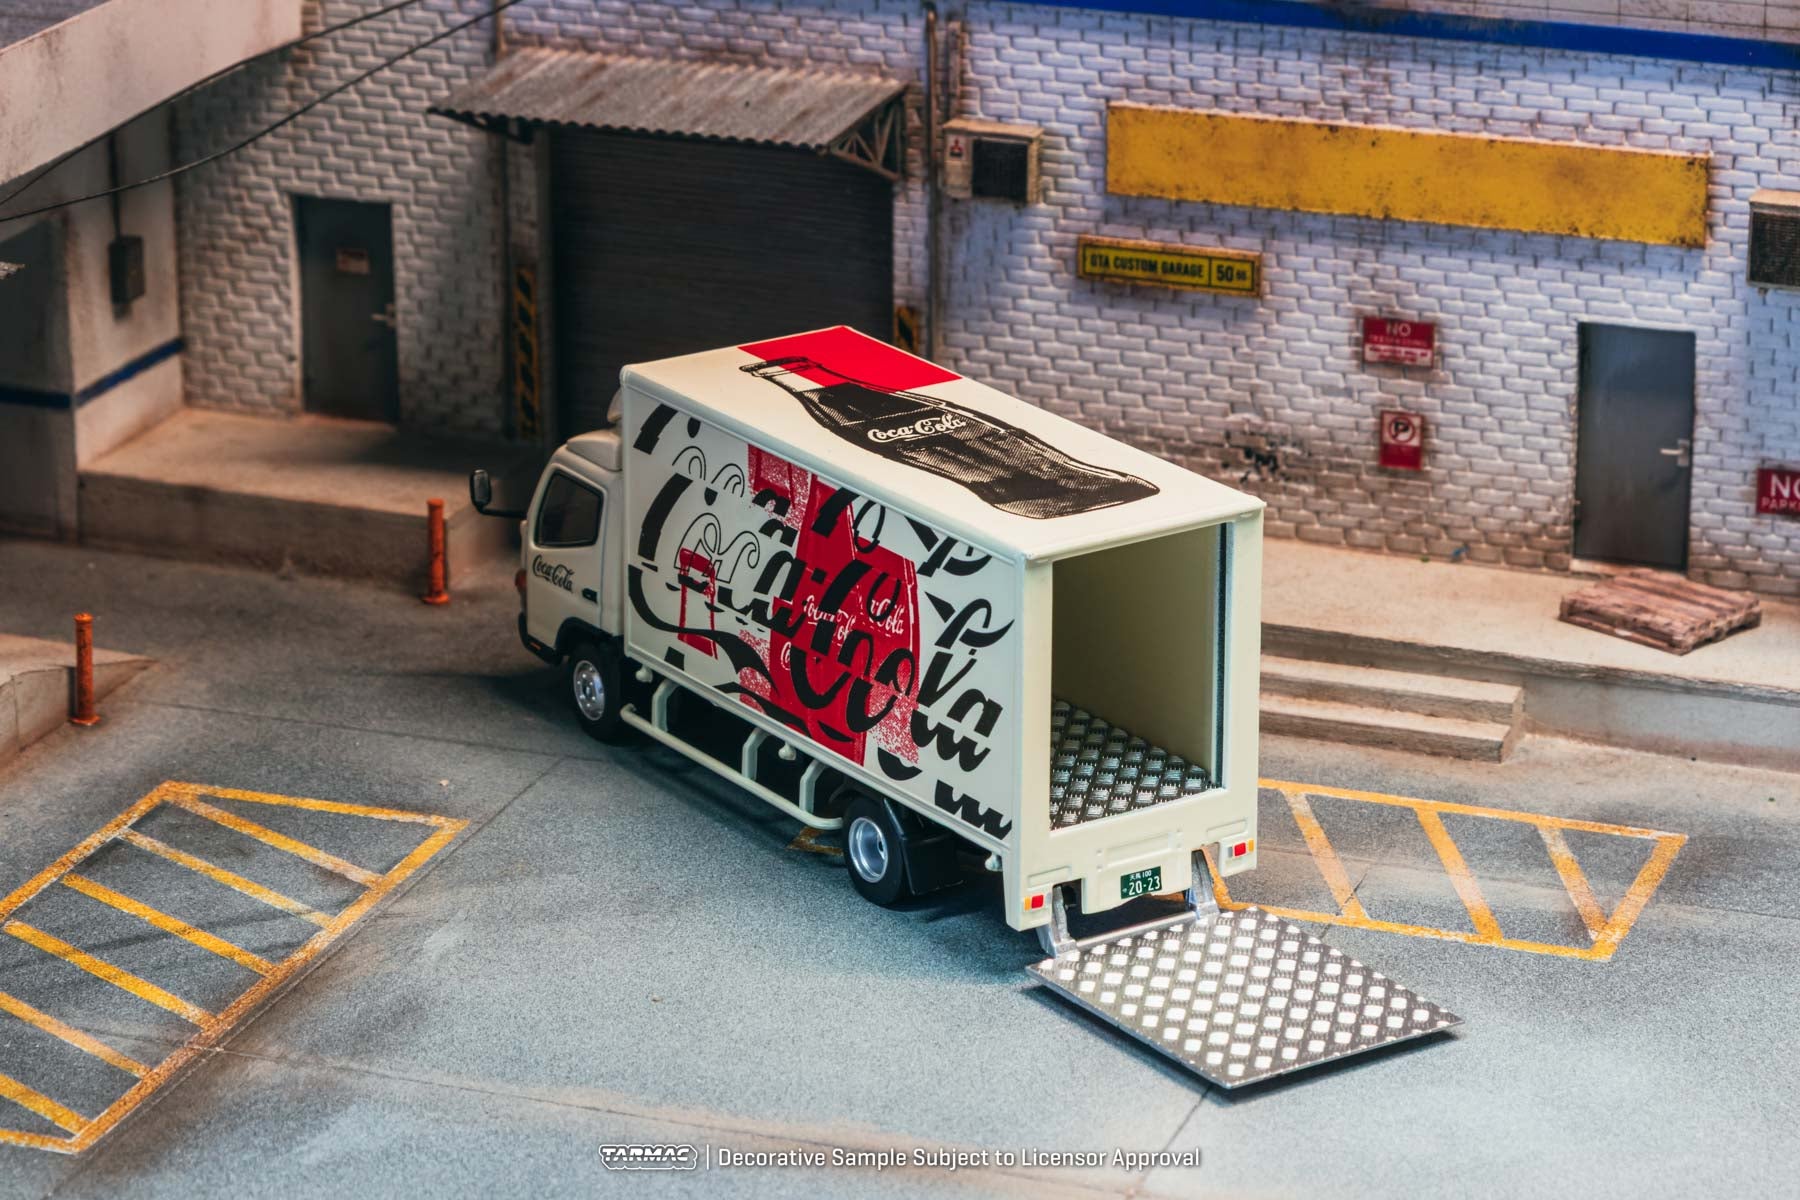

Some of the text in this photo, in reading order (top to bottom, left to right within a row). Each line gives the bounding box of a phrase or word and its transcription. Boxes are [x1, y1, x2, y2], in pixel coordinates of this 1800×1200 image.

[1114, 256, 1158, 273] CUSTOM
[1161, 261, 1204, 278] GARAGE
[1216, 264, 1234, 282] 50
[1385, 322, 1412, 338] NO
[867, 413, 967, 443] Coca-Cola
[1142, 870, 1151, 878] 100
[1129, 876, 1161, 895] 20-23
